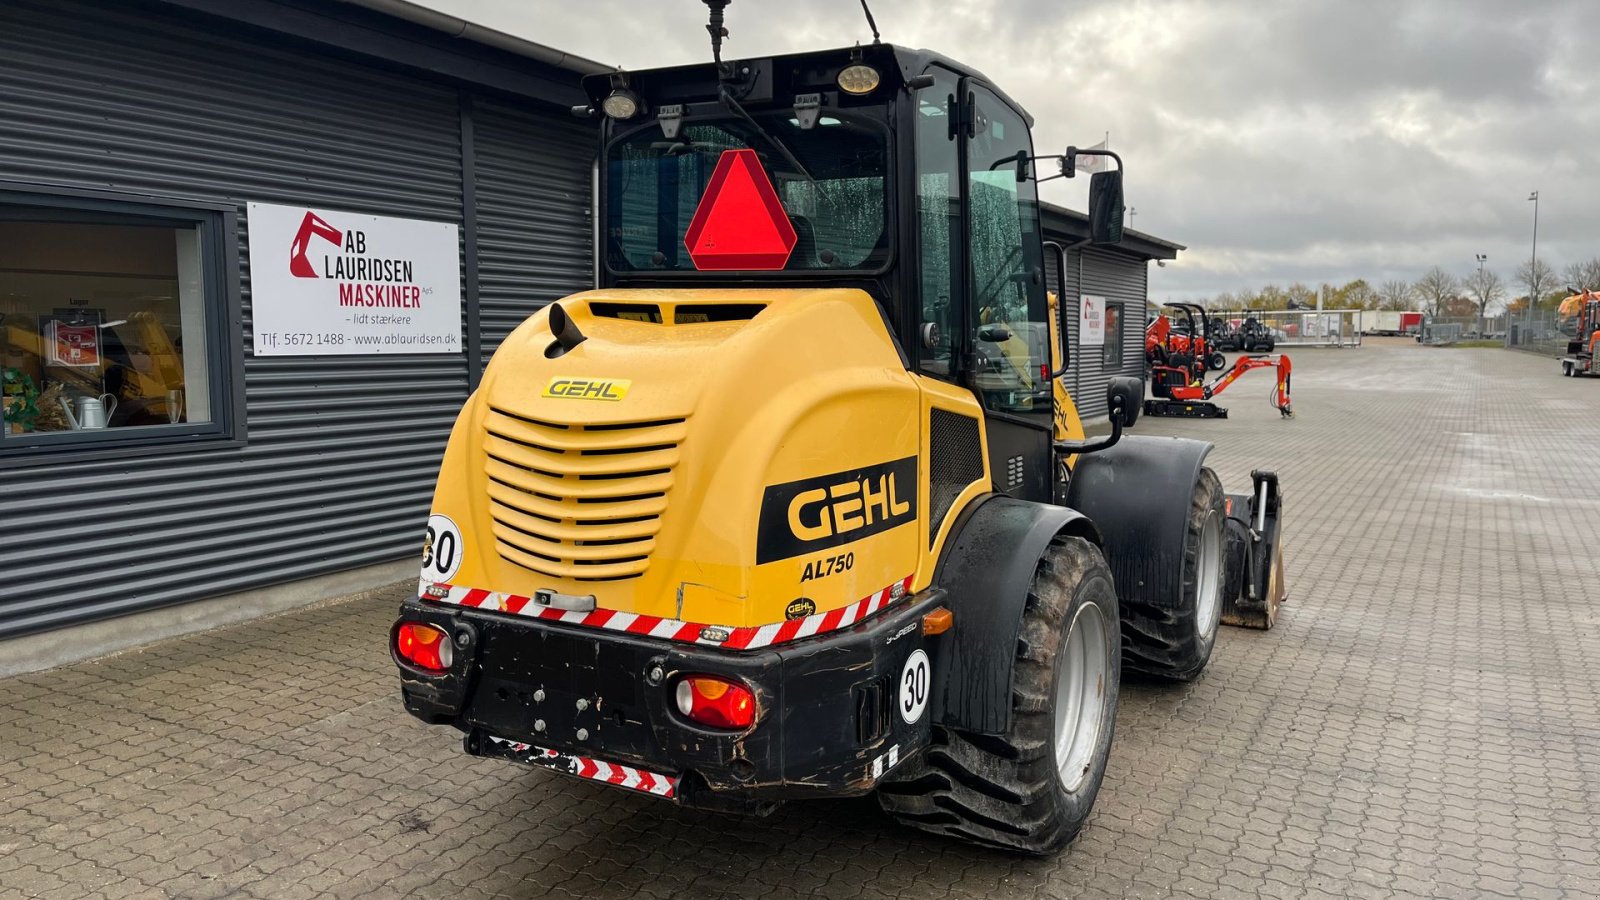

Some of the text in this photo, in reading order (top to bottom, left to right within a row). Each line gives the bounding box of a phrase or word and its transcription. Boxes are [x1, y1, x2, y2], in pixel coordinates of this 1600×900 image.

[345, 230, 366, 254] AB
[325, 255, 413, 283] LAURIDSEN
[340, 283, 433, 308] MASKINER ApS
[353, 313, 369, 324] lidt
[371, 314, 411, 325] stærkere
[261, 333, 280, 348] Tlf.
[284, 333, 313, 345] 5672
[317, 333, 344, 345] 1488
[354, 333, 457, 345] www.ablauridsen.dk
[549, 380, 618, 398] GEHL
[787, 471, 910, 542] GEHL
[800, 552, 854, 583] AL750
[787, 601, 813, 614] GEHL
[904, 661, 926, 713] 30
